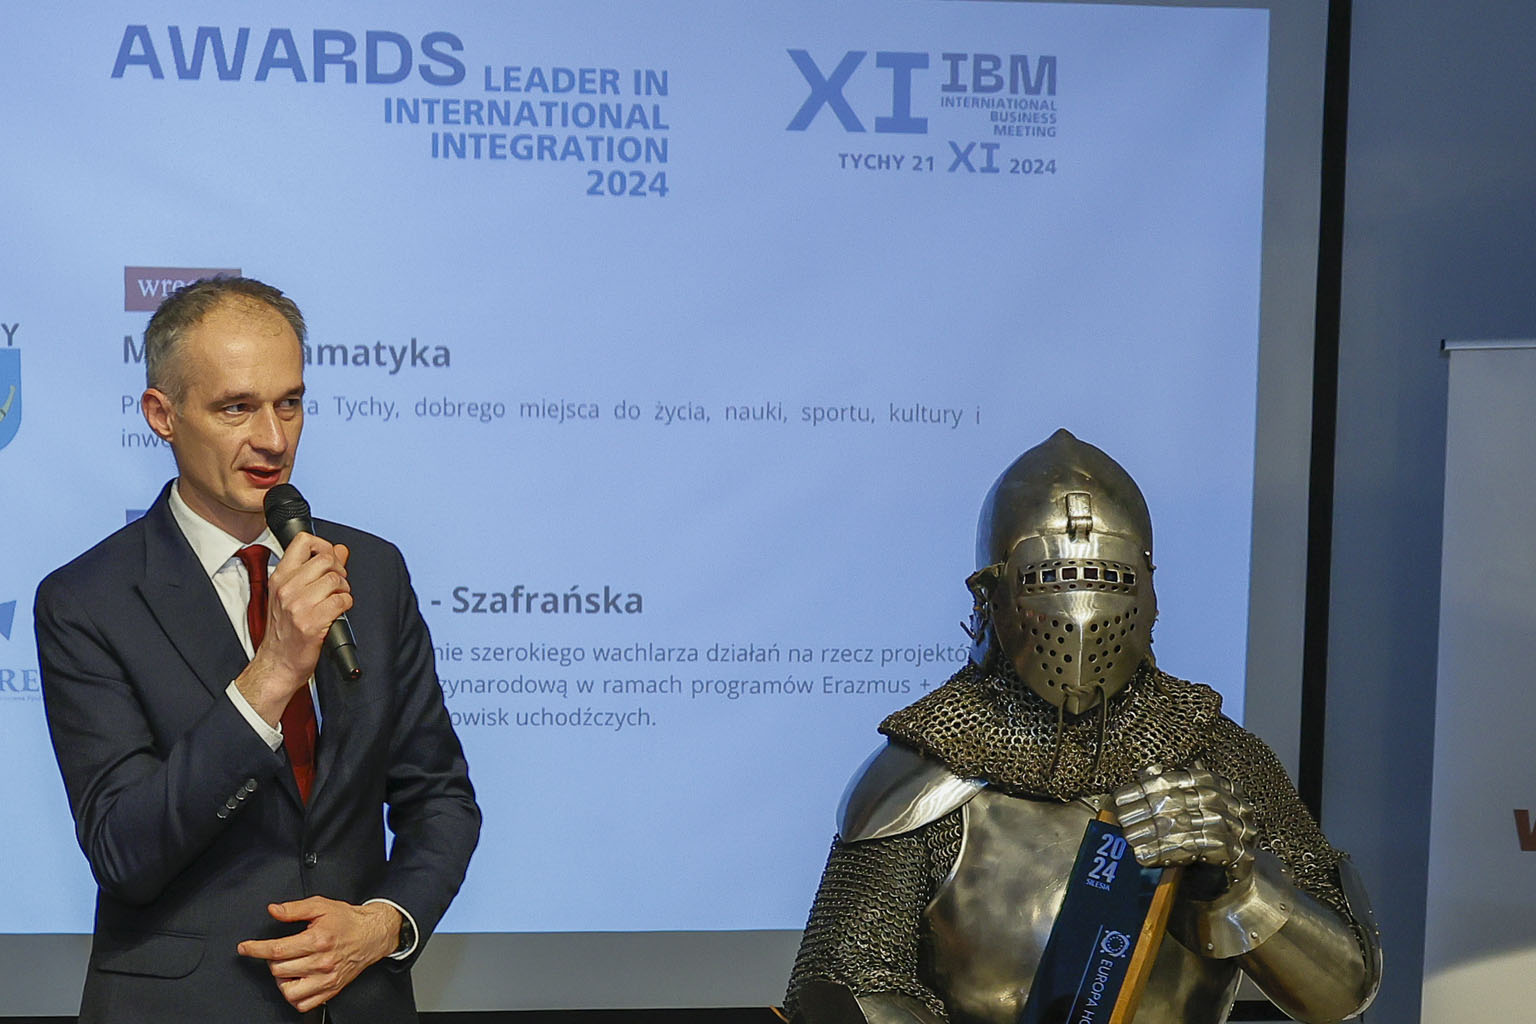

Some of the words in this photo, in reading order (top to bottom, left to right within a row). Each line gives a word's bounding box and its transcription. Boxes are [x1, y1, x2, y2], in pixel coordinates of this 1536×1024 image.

[110, 24, 466, 86] AWARDS
[484, 65, 621, 96] LEADER
[633, 69, 669, 97] IN
[940, 52, 1057, 96] IBM
[785, 48, 930, 134] XI
[384, 97, 670, 130] INTERNATIONAL
[990, 111, 1057, 124] BUSINESS
[993, 125, 1056, 137] MEETING
[431, 132, 669, 164] INTEGRATION
[838, 153, 904, 171] TYCHY
[912, 155, 935, 172] 21
[947, 140, 1000, 174] XI
[1009, 159, 1057, 175] 2024
[586, 170, 670, 198] 2024
[333, 396, 399, 421] Tychy,
[414, 396, 506, 423] dobrego
[519, 398, 600, 423] miejsca
[614, 399, 641, 420] do
[655, 400, 711, 425] życia,
[725, 400, 788, 424] nauki,
[801, 402, 876, 426] sportu,
[890, 402, 963, 428] kultury
[976, 404, 981, 425] i
[452, 584, 643, 615] Szafrańska
[471, 643, 585, 667] szerokiego
[593, 643, 698, 662] wachlarza
[707, 643, 781, 663] działań
[788, 647, 814, 663] na
[821, 647, 874, 663] rzecz
[577, 679, 594, 694] w
[604, 675, 682, 694] ramach
[692, 675, 814, 699] programów
[516, 707, 657, 731] uchodźczych.
[1096, 833, 1128, 860] 20
[1088, 856, 1119, 883] 24
[1085, 958, 1114, 1006] EUROPA
